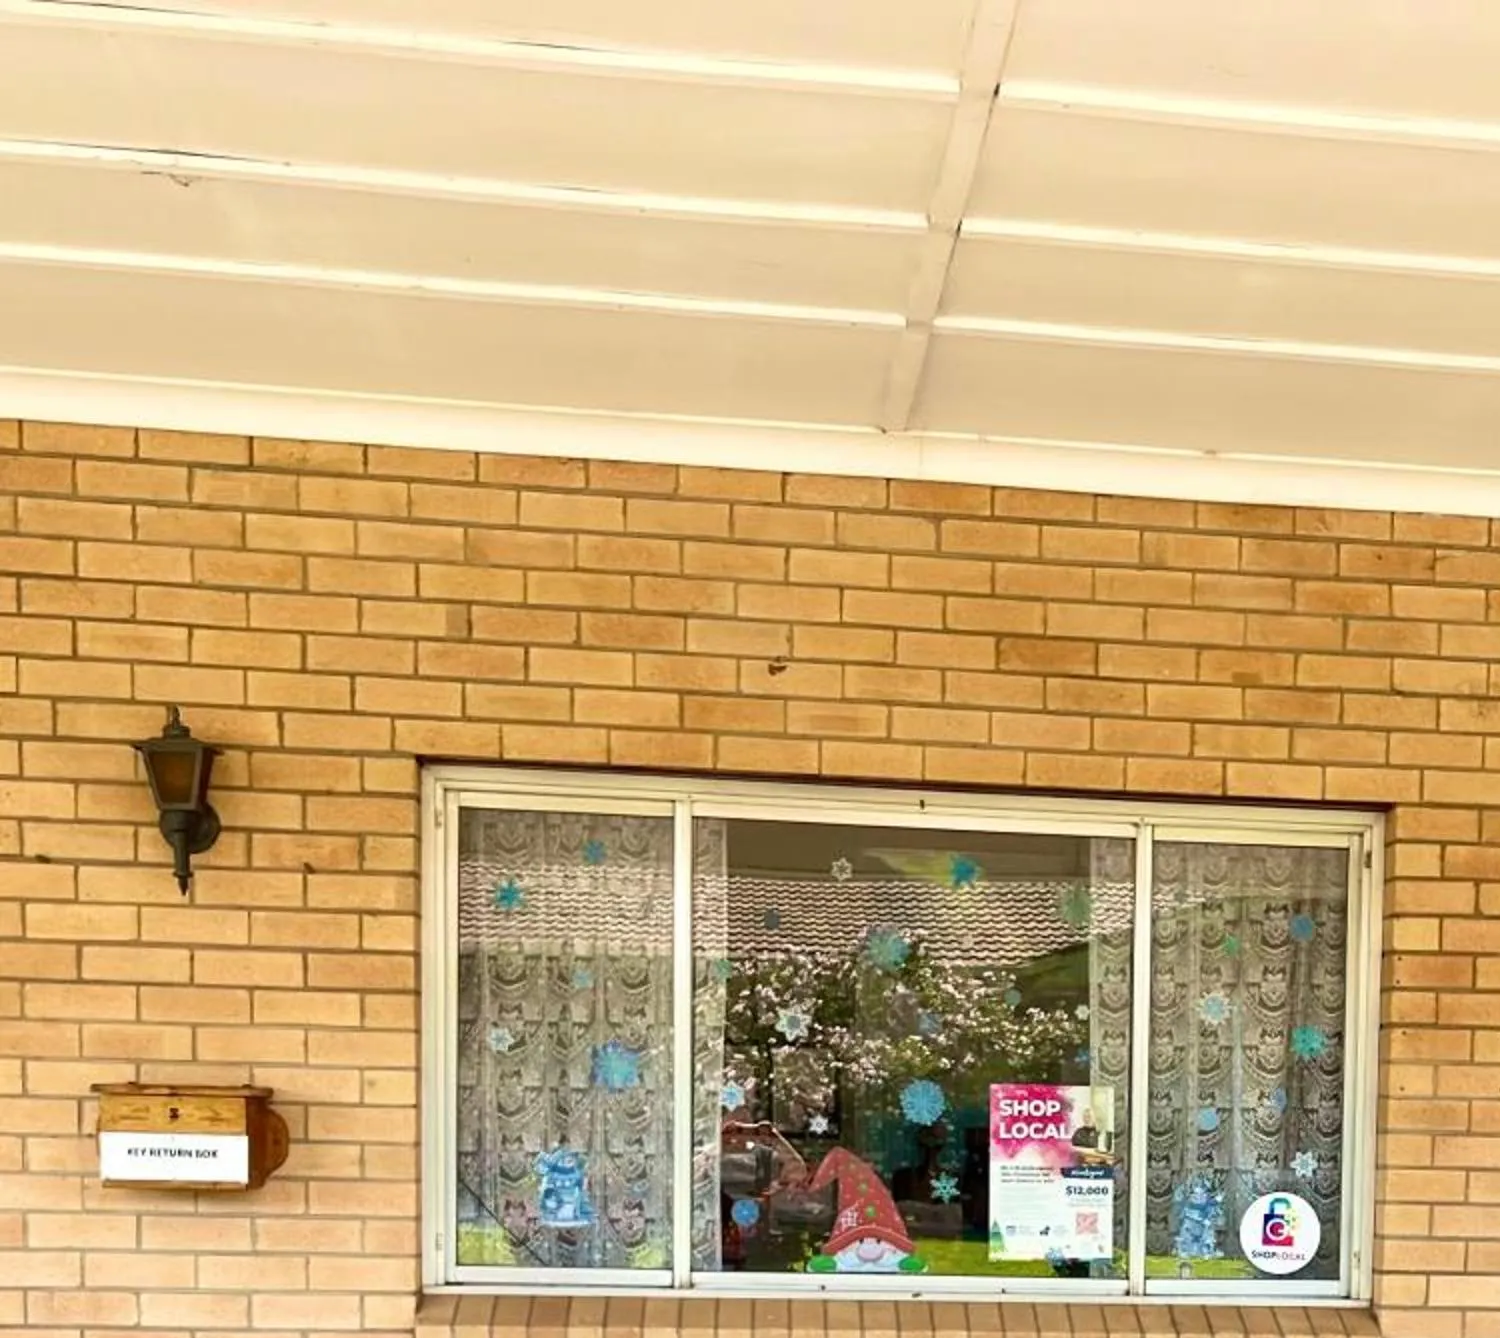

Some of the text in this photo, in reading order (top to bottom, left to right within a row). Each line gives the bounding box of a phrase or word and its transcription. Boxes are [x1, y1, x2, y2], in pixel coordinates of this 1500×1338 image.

[1000, 1099, 1060, 1117] SHOP
[1000, 1121, 1072, 1139] LOCAL
[127, 1148, 218, 1159] KEY RETURN BOX
[1065, 1185, 1109, 1197] $12,000
